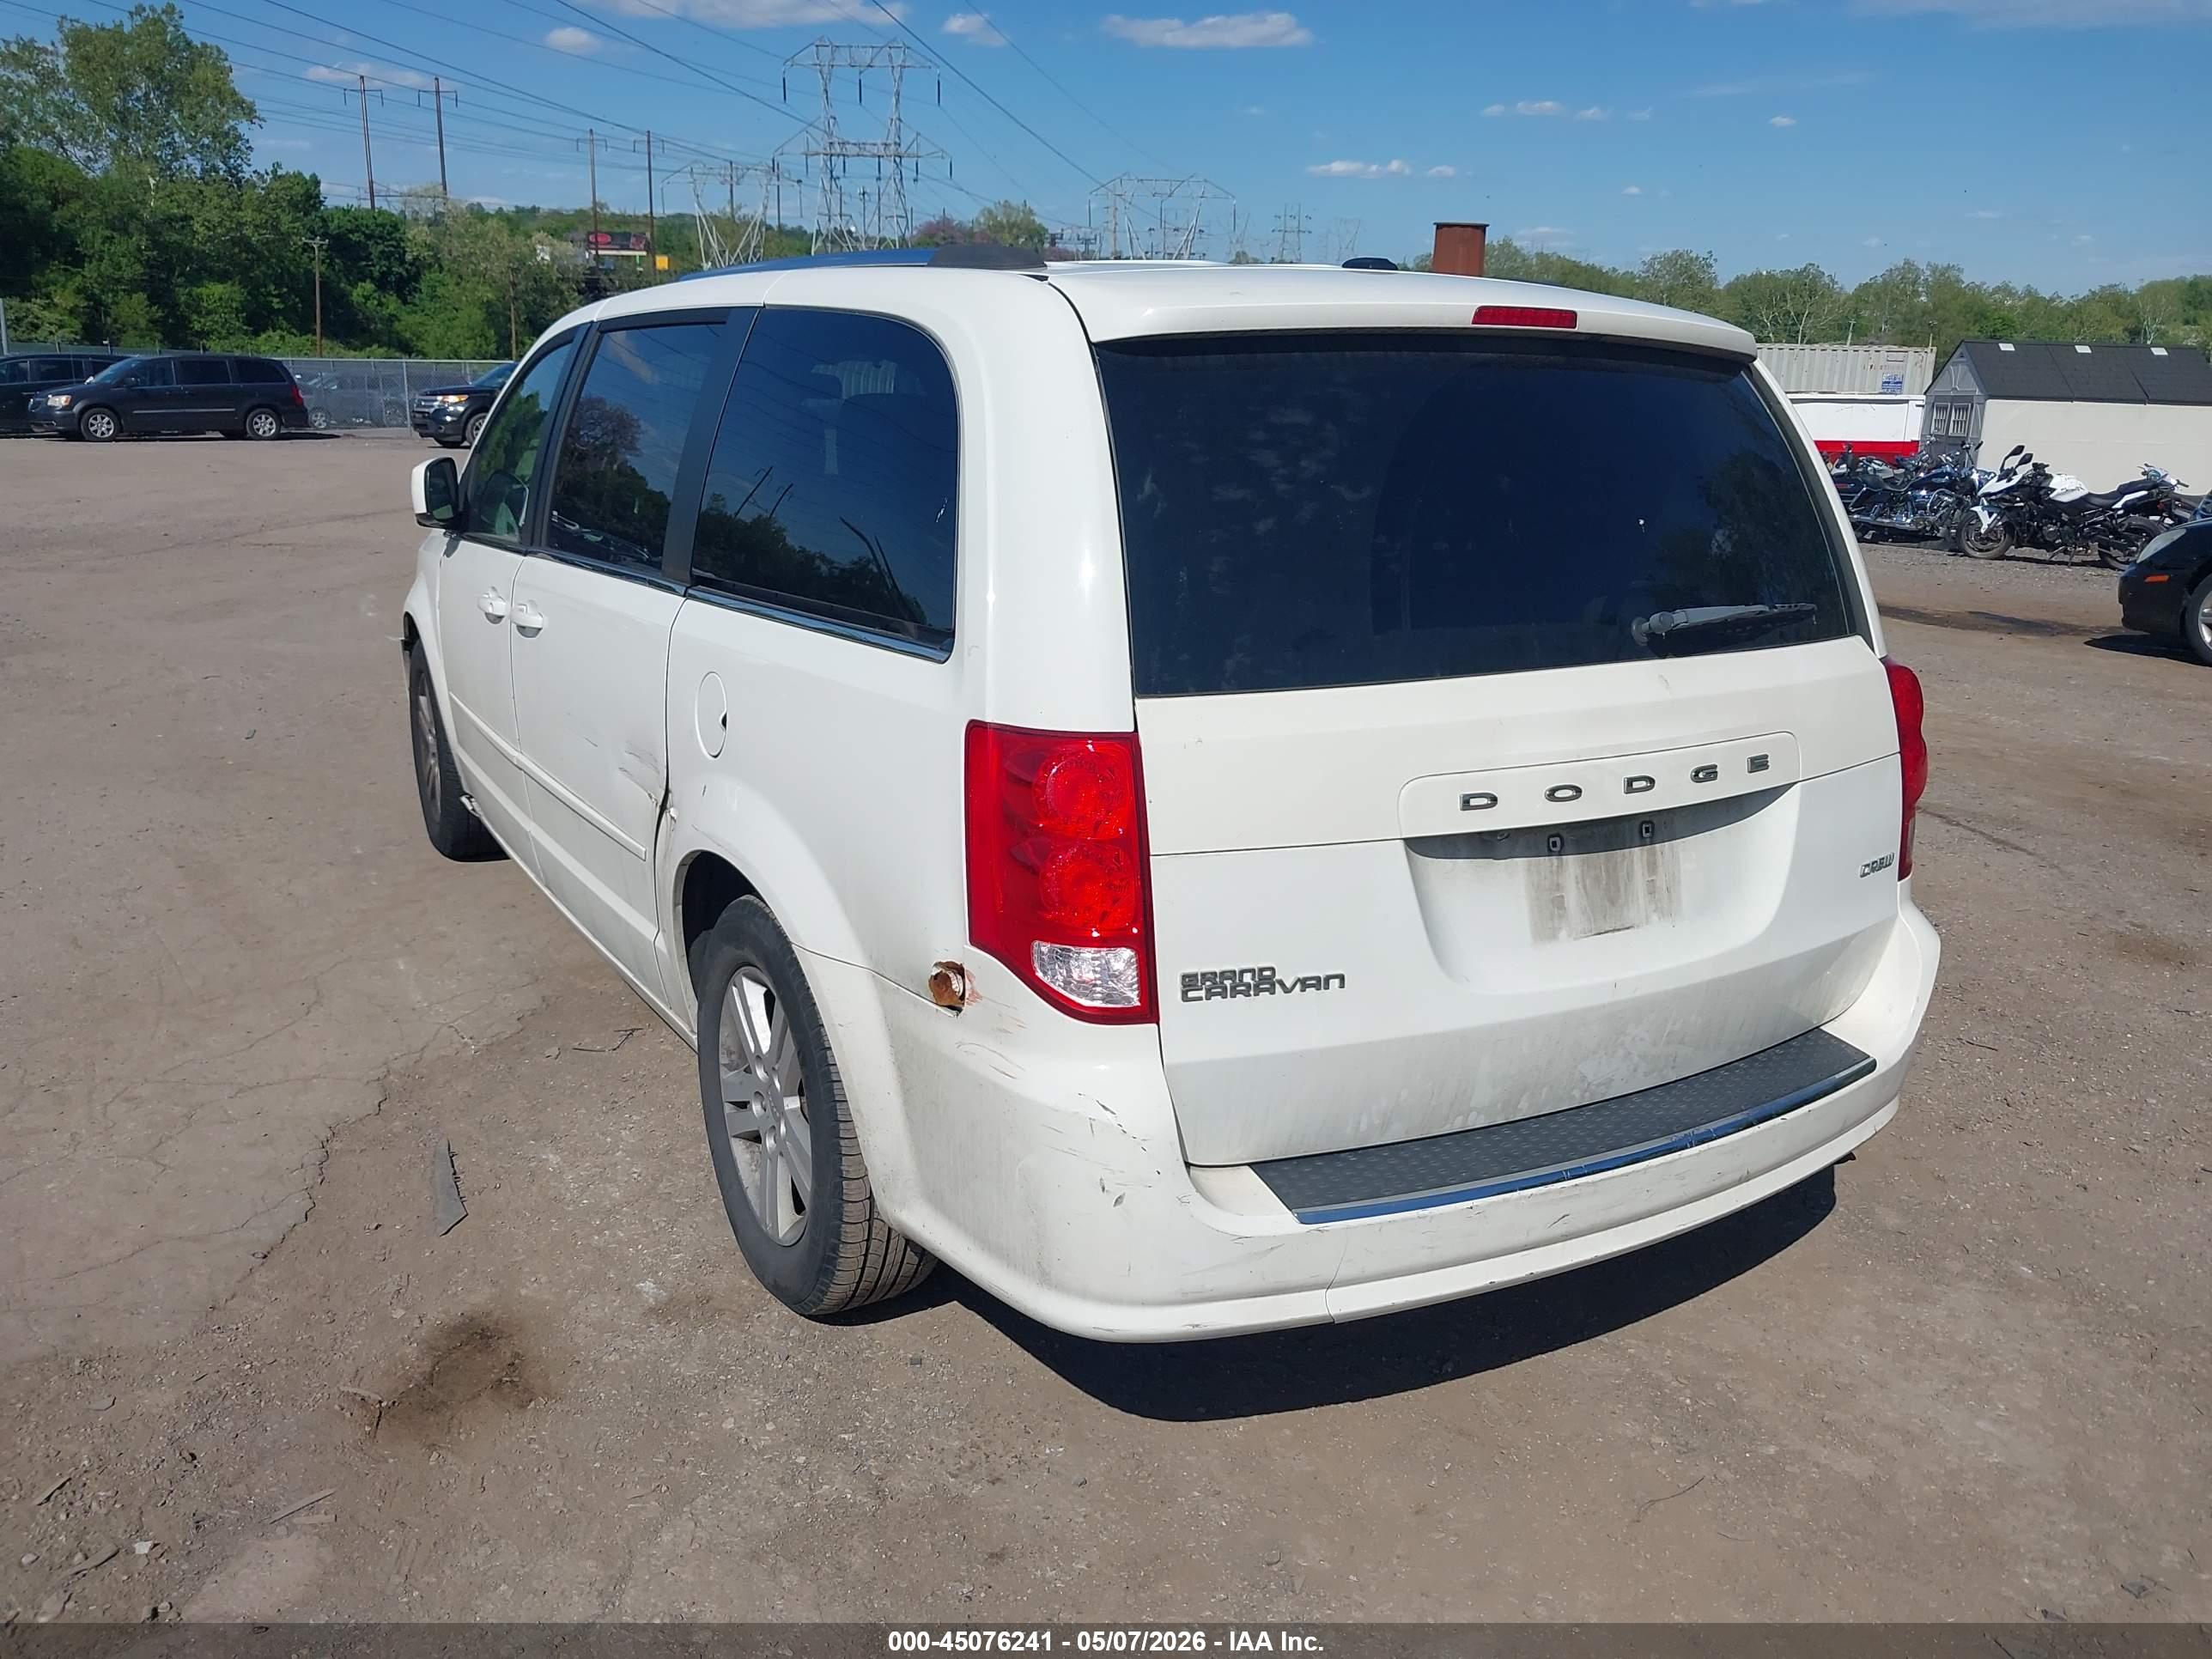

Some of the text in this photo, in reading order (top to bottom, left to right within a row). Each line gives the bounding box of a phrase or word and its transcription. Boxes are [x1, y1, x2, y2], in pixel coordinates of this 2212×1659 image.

[1460, 754, 1769, 811] DODGE
[1860, 852, 1894, 878] CREW
[1182, 966, 1276, 987] GRAND
[1182, 973, 1346, 1002] CARAVAN
